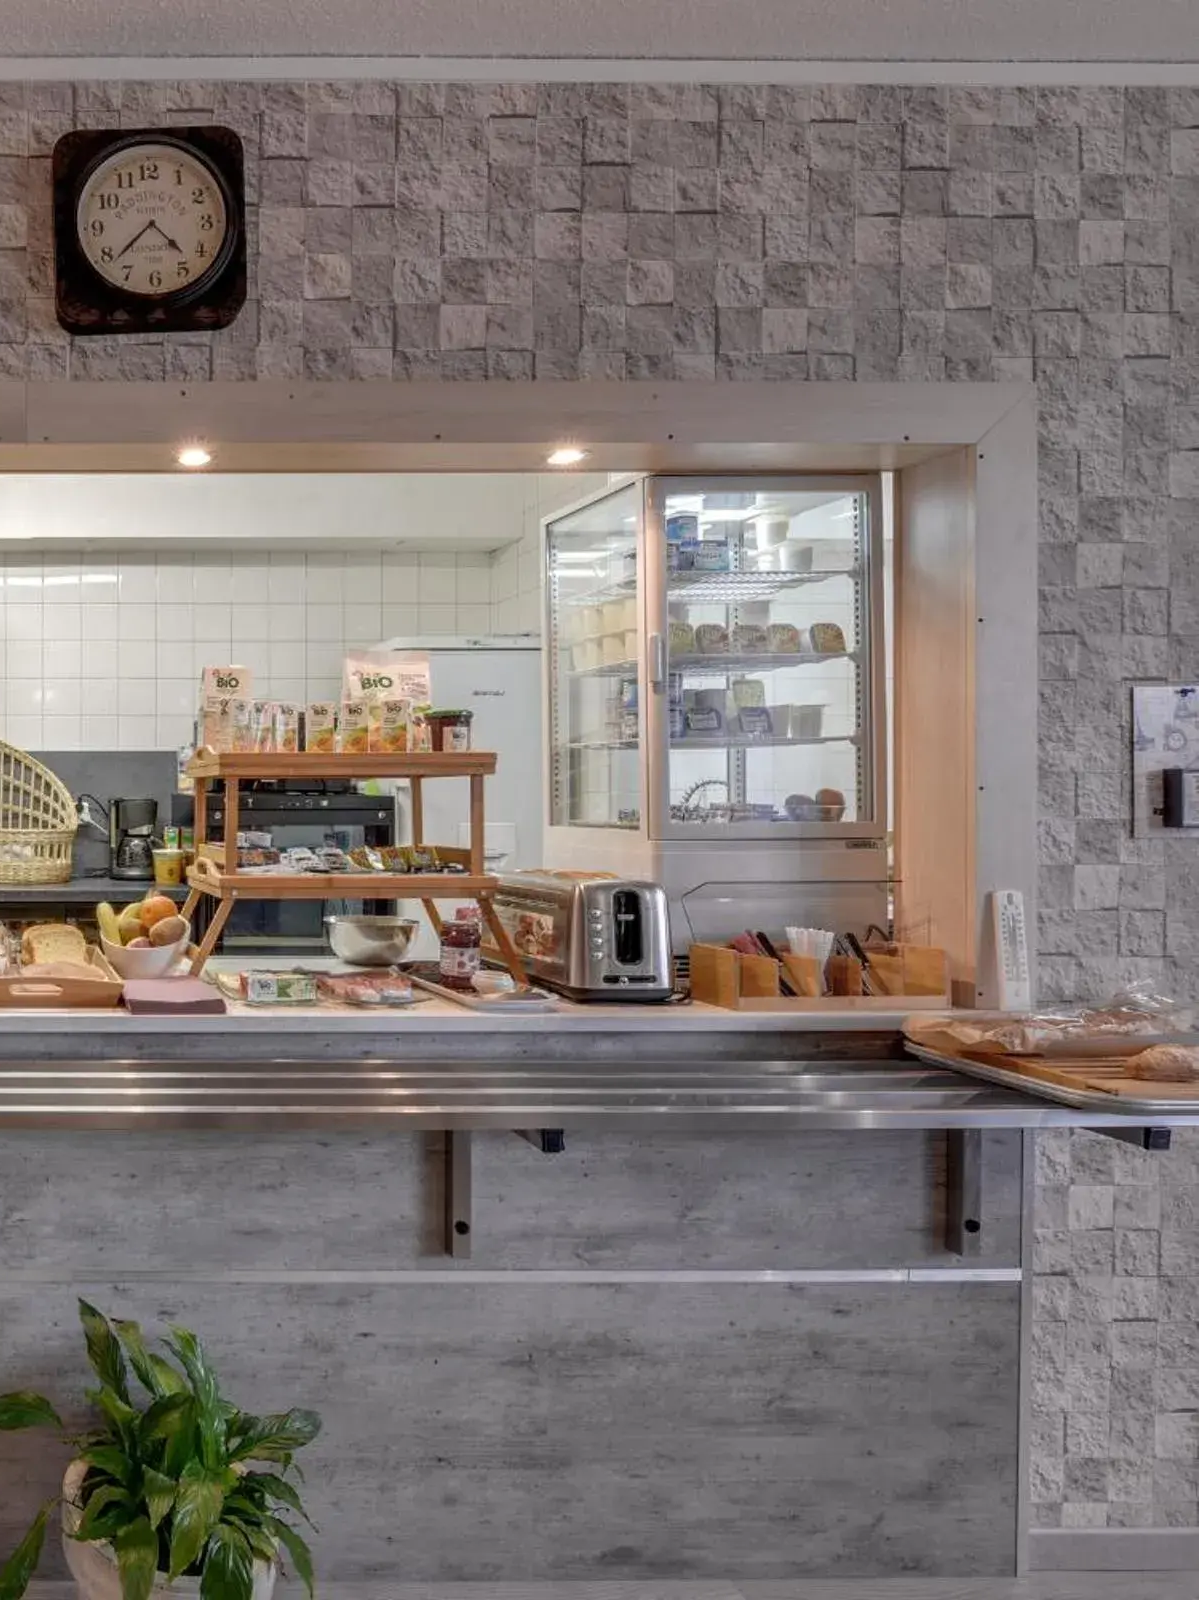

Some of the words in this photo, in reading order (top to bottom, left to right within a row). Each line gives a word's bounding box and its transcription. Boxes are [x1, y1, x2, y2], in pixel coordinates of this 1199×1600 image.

[117, 172, 133, 188] 11
[138, 163, 160, 181] 12
[175, 169, 183, 186] 1
[98, 193, 120, 210] 10
[191, 188, 206, 205] 2
[90, 219, 105, 237] 9
[200, 214, 214, 231] 3
[100, 246, 114, 264] 8
[194, 240, 209, 258] 4
[121, 264, 134, 282] 7
[176, 261, 190, 278] 5
[148, 270, 162, 287] 6
